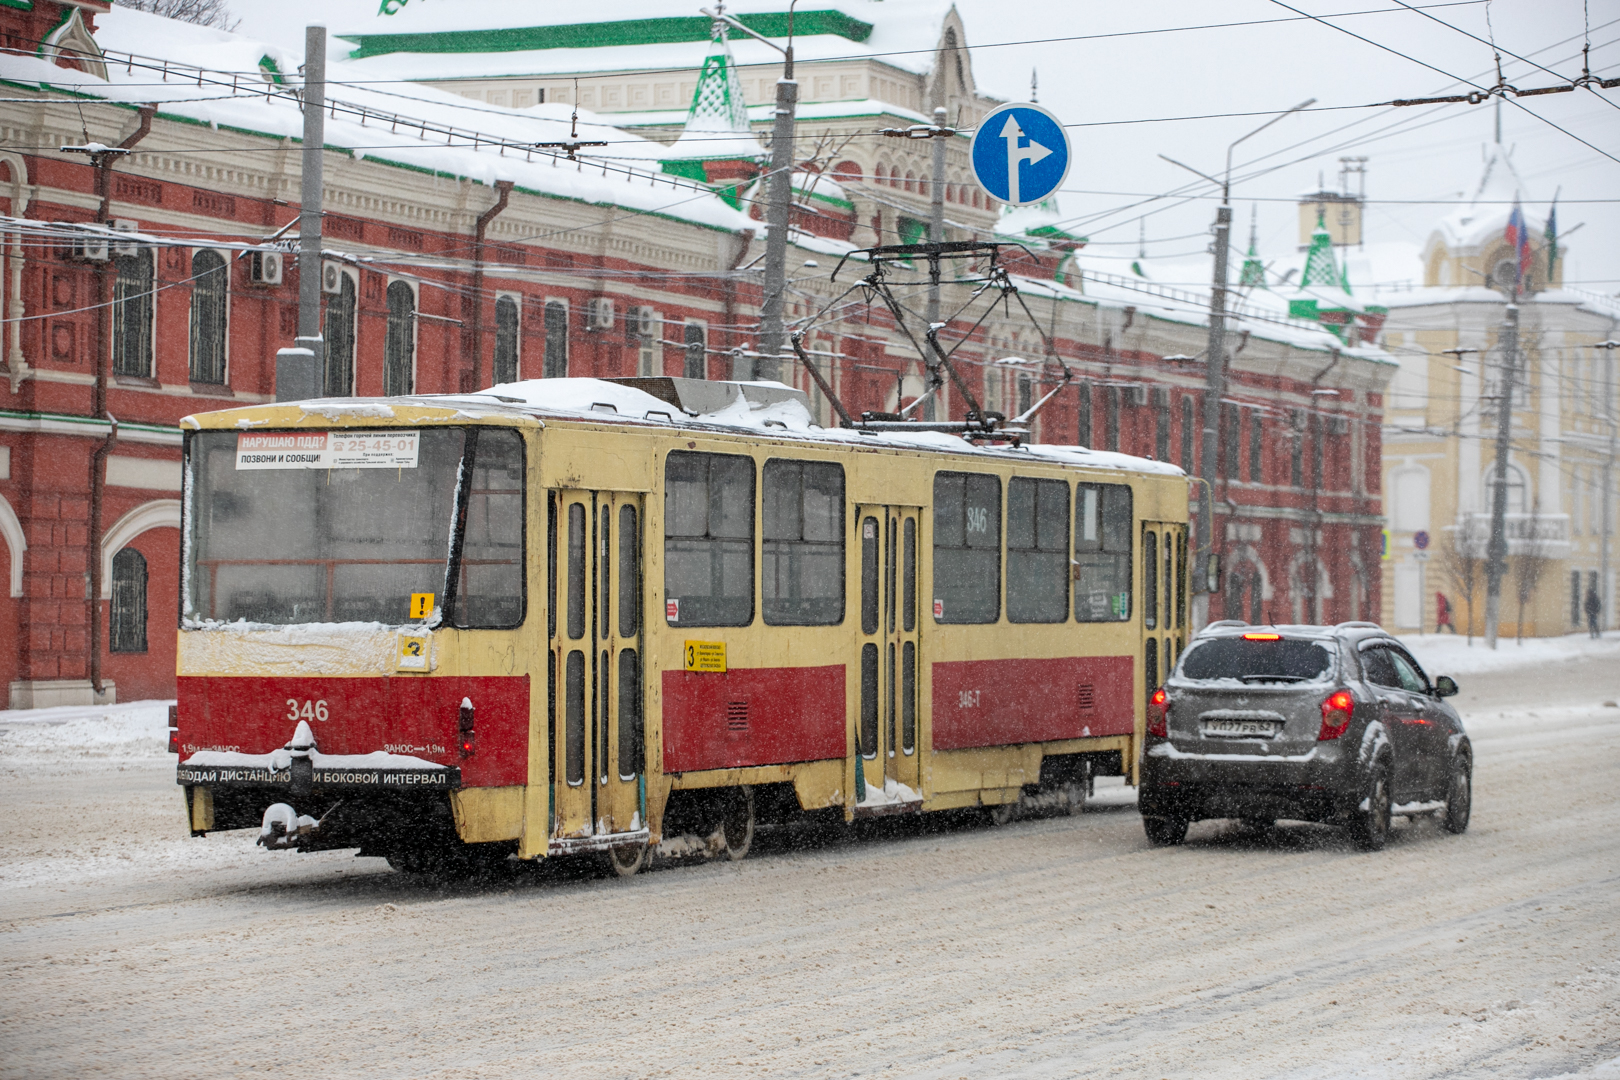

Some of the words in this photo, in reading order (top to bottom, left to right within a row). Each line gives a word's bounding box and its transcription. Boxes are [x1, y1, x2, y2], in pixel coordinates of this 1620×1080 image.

[242, 436, 295, 448] НАРУШАЮ
[297, 436, 325, 449] ПДД?
[348, 439, 414, 452] 25-45-01
[241, 454, 277, 464] ПОЗВОНИ
[278, 454, 284, 463] И
[285, 454, 321, 464] СООБЩИ!
[967, 507, 987, 534] 346
[688, 645, 695, 668] 3
[286, 698, 329, 722] 346
[384, 744, 414, 753] ЗАНОС
[313, 773, 321, 783] И
[323, 772, 379, 784] БОКОВОЙ
[383, 773, 446, 786] ИНТЕРВАЛ
